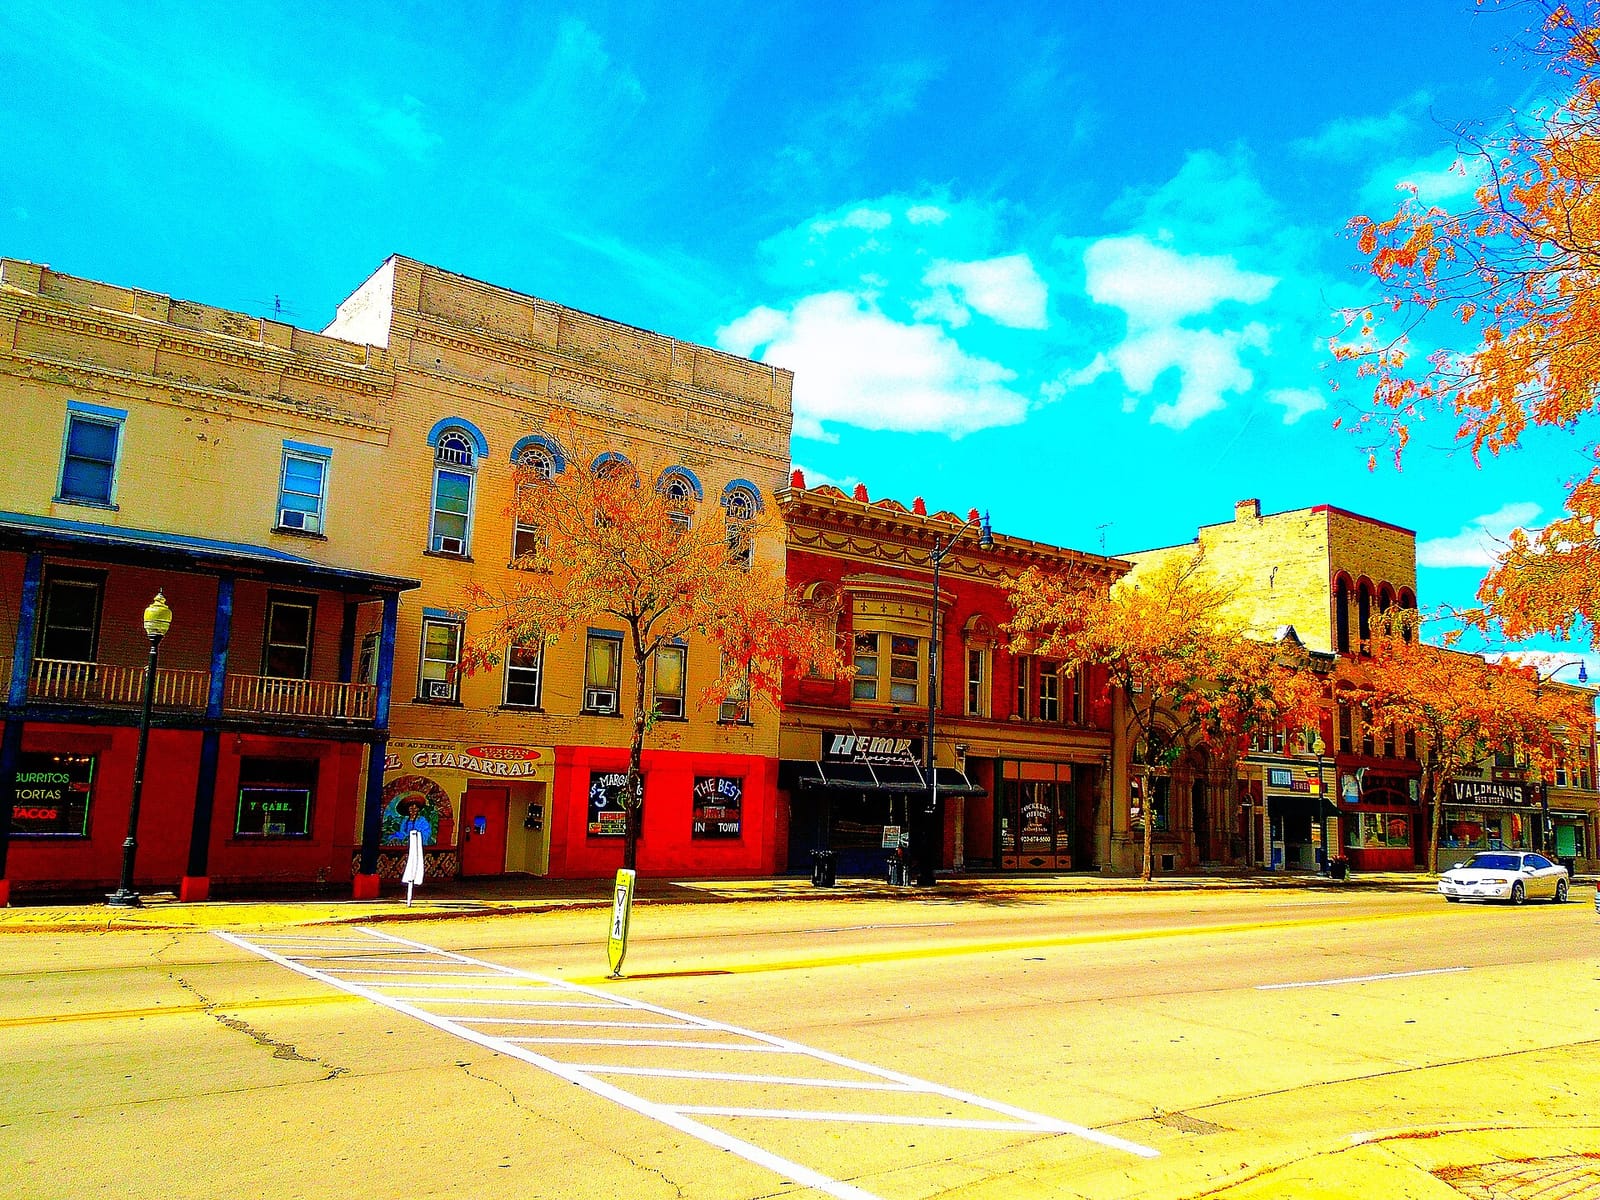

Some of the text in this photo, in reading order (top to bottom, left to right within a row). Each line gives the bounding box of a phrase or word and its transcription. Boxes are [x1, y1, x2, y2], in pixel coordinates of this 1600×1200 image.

[408, 743, 457, 751] AUTHENTIC
[480, 747, 530, 756] MEXICAN
[412, 752, 536, 776] CHAPARRAL
[15, 772, 70, 784] BURRITOS
[15, 789, 62, 800] TORTAS
[694, 778, 742, 801] THE BEST
[12, 806, 58, 819] TACOS
[694, 822, 739, 833] IN TOWN
